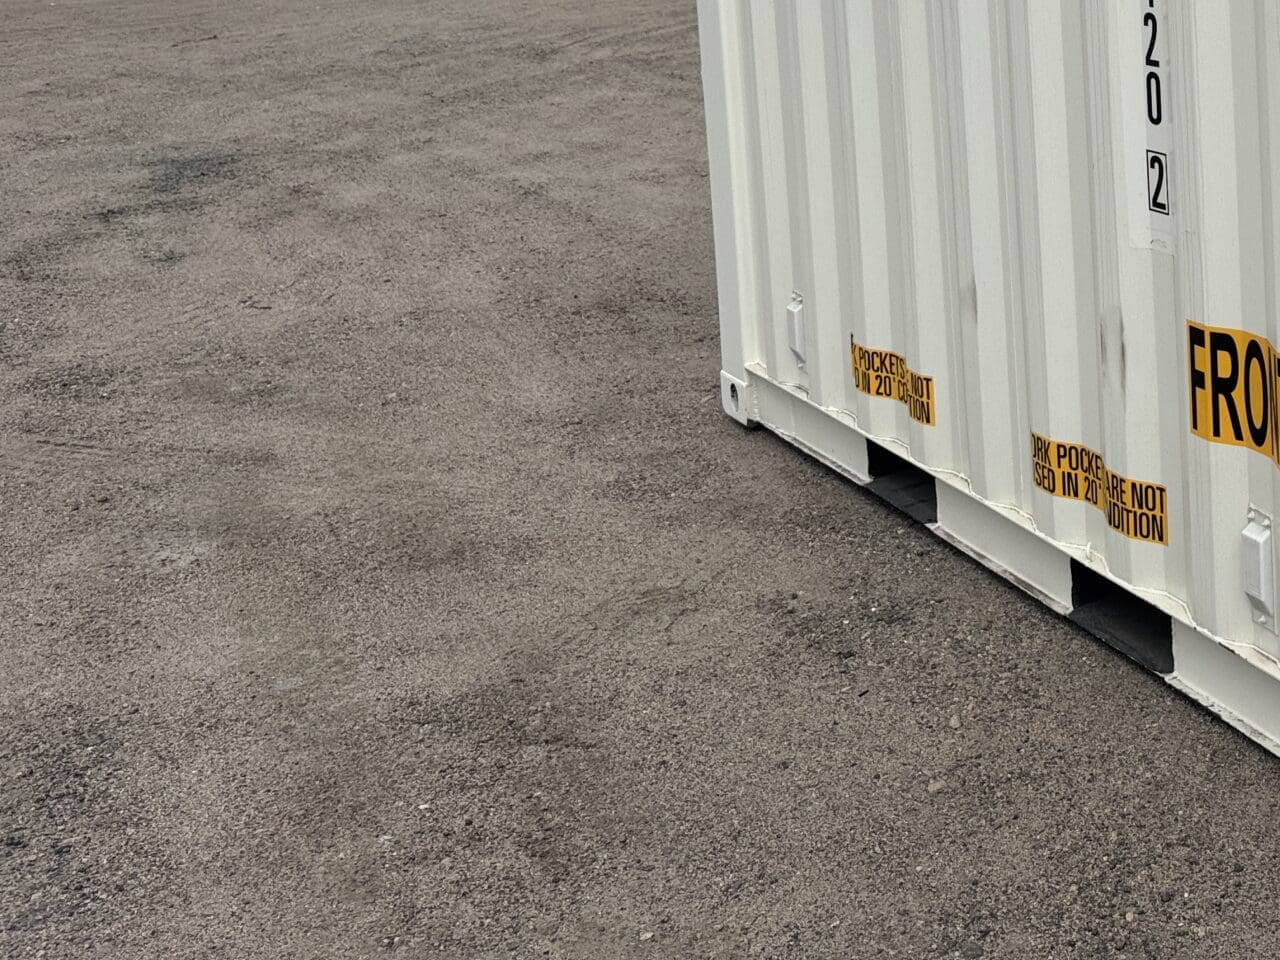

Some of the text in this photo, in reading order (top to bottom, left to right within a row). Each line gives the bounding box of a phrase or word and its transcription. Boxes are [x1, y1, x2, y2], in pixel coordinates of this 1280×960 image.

[1149, 155, 1167, 211] 2
[858, 347, 905, 379] POCKETS
[911, 373, 932, 400] NOT
[862, 371, 871, 394] IN
[1033, 460, 1055, 494] SED
[1062, 471, 1079, 498] IN
[1107, 500, 1164, 542] NDITION
[1057, 443, 1104, 481] POCKE
[1131, 482, 1166, 514] NOT
